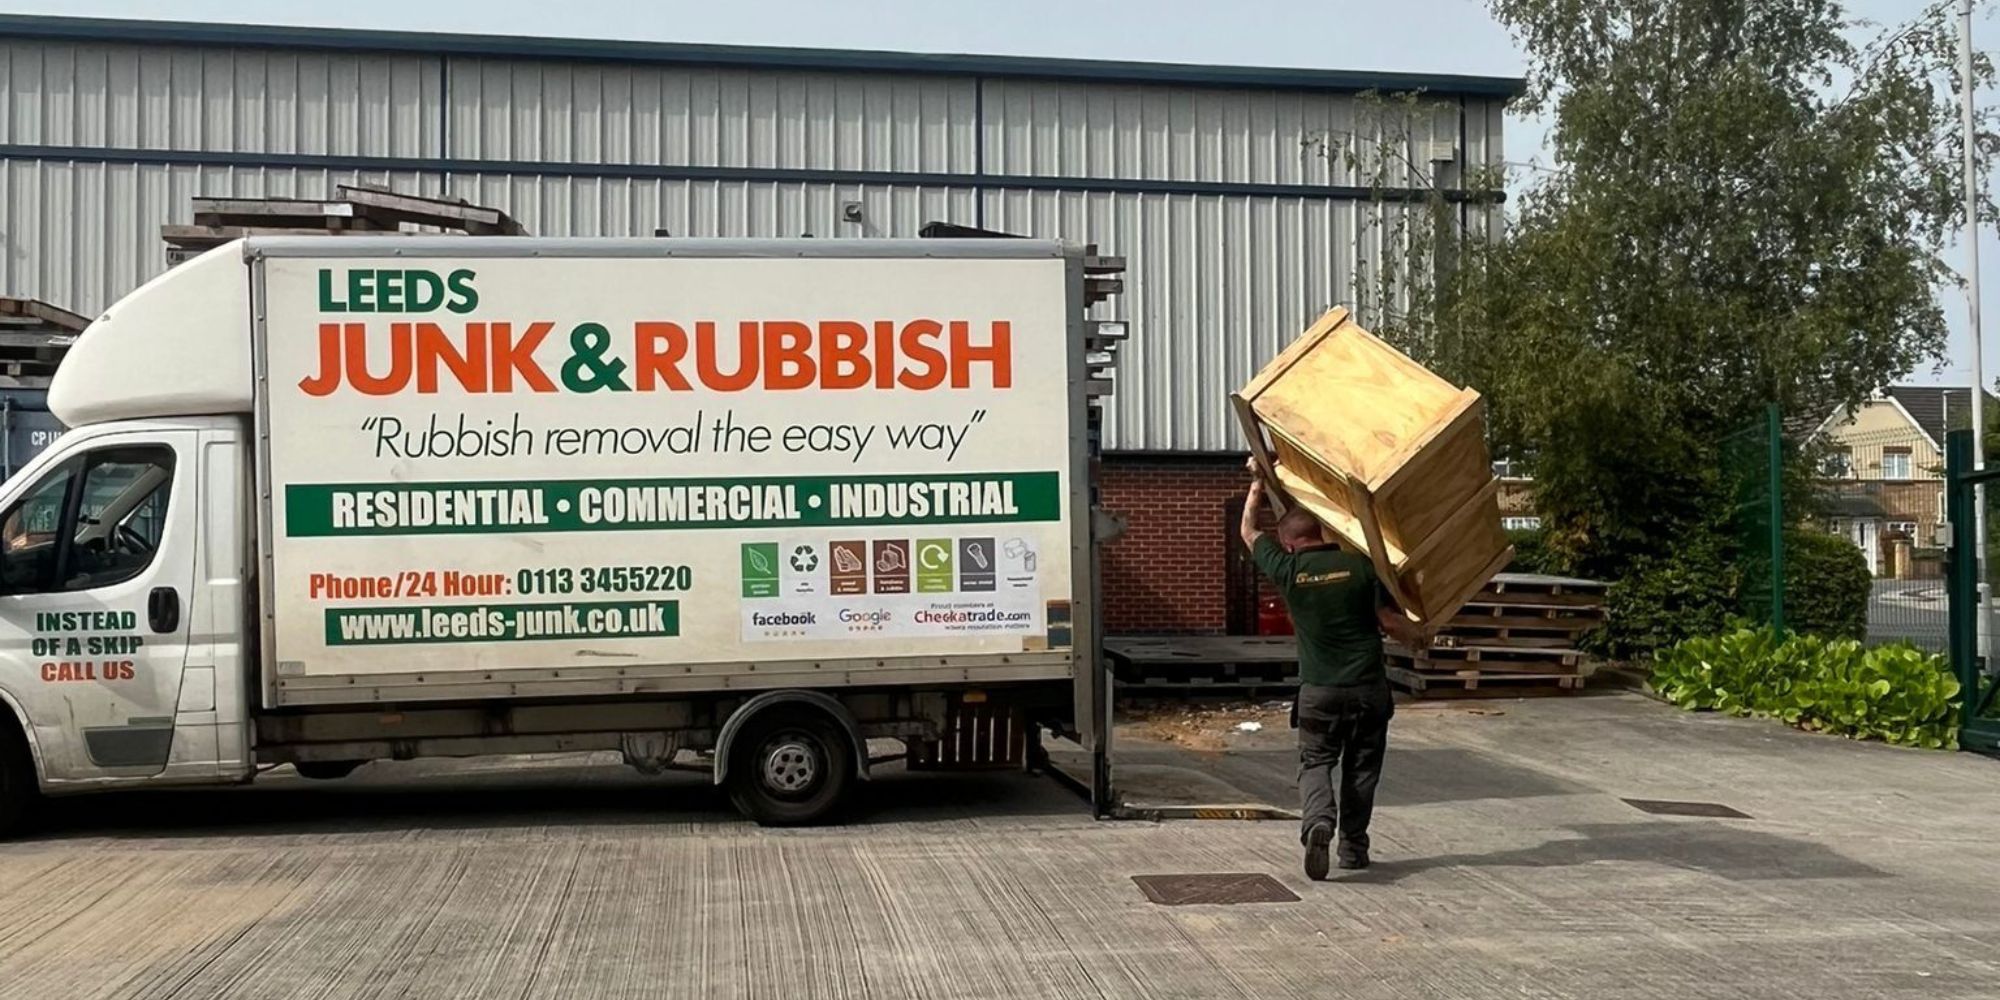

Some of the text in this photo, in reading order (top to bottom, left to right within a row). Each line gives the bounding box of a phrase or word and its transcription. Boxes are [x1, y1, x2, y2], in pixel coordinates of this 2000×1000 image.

[318, 268, 479, 314] LEEDS
[298, 318, 1012, 397] JUNK&RUBBISH
[361, 409, 987, 463] “Rubbish removal the easy way”
[332, 480, 1019, 528] RESIDENTIAL COMMERCIAL INDUSTRIAL
[309, 565, 693, 600] Phone/24 Hour: 0113 3455220
[36, 611, 137, 632] INSTEAD
[339, 603, 666, 641] www.leeds-junk.co.uk
[752, 611, 817, 626] facebook
[838, 608, 892, 626] Google
[914, 609, 1032, 624] Checkatrade.com
[32, 636, 144, 657] OF A SKIP
[41, 660, 135, 682] CALL US
